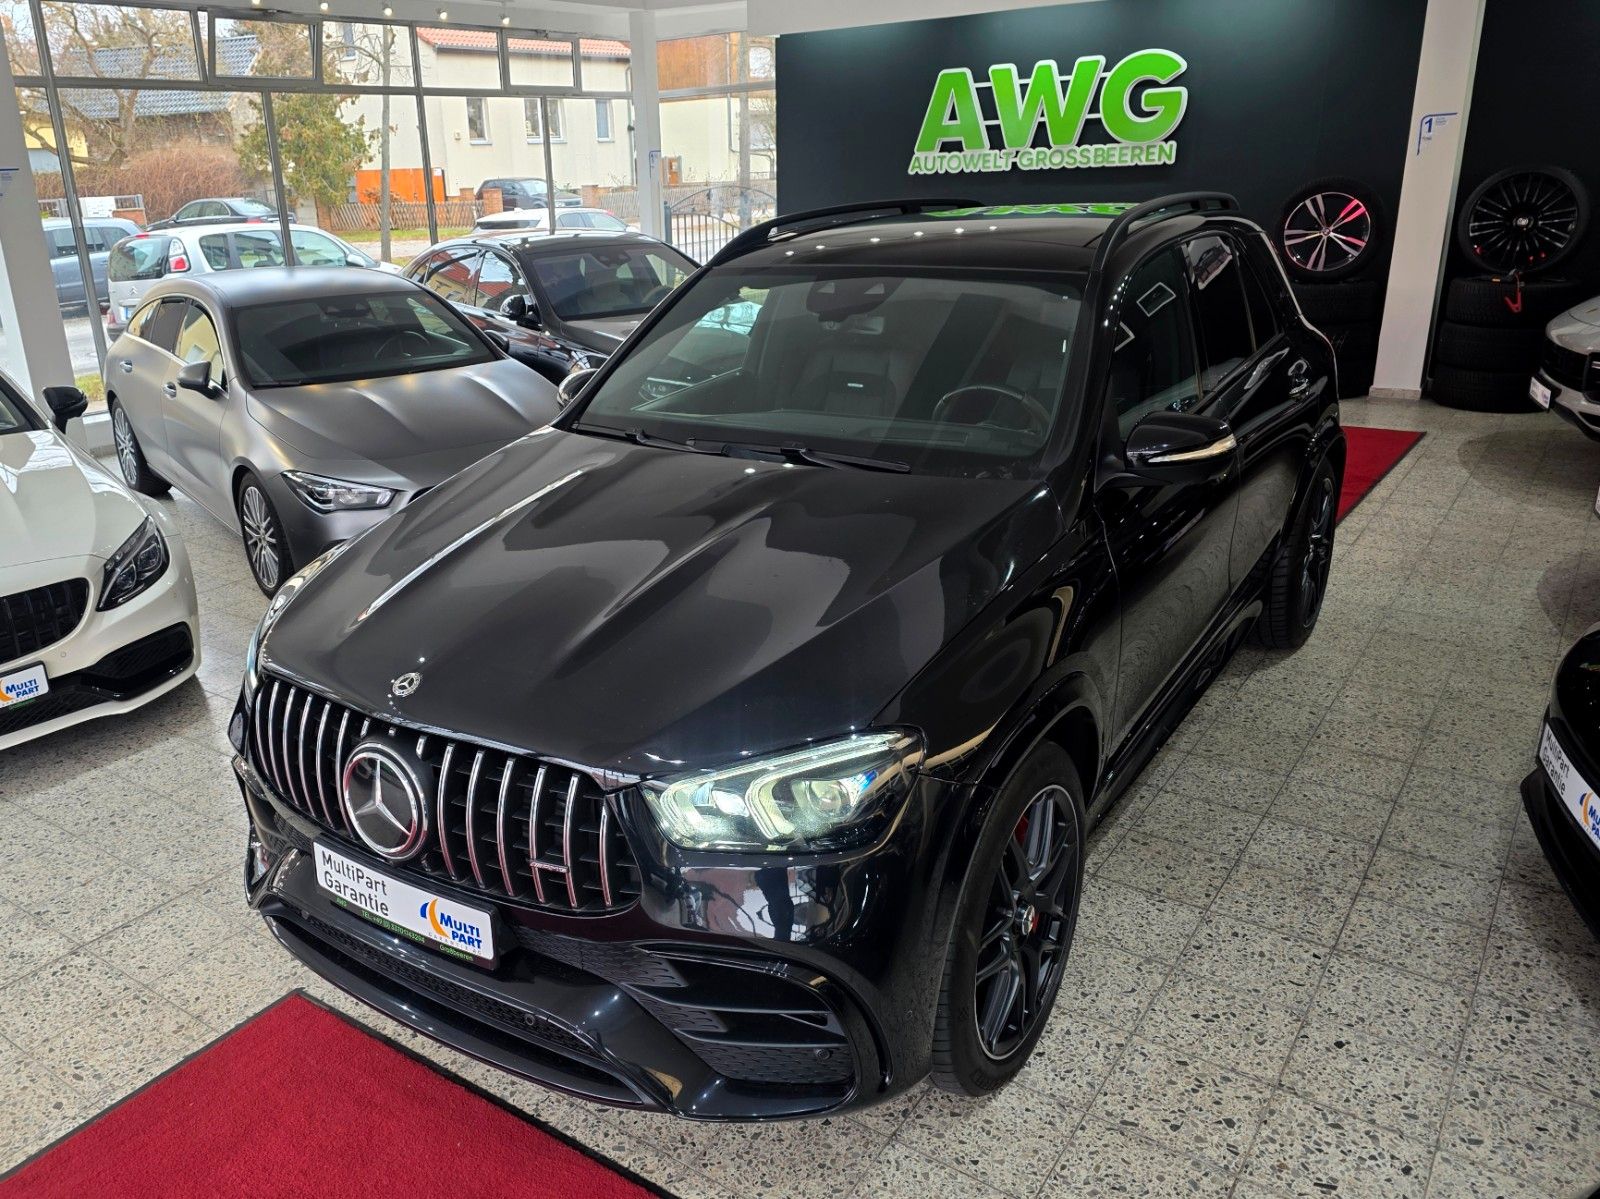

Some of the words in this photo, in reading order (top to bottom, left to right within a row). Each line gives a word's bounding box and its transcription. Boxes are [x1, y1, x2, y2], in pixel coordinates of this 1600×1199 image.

[913, 48, 1188, 153] AWG
[908, 150, 1015, 175] AUTOWELT
[1016, 141, 1177, 171] GROSSBEEREN
[5, 678, 37, 694] MULTI
[16, 685, 39, 698] PART
[322, 850, 387, 896] MultiPart
[324, 871, 389, 917] Garantie
[440, 912, 480, 938] MULTI
[451, 930, 483, 949] PART
